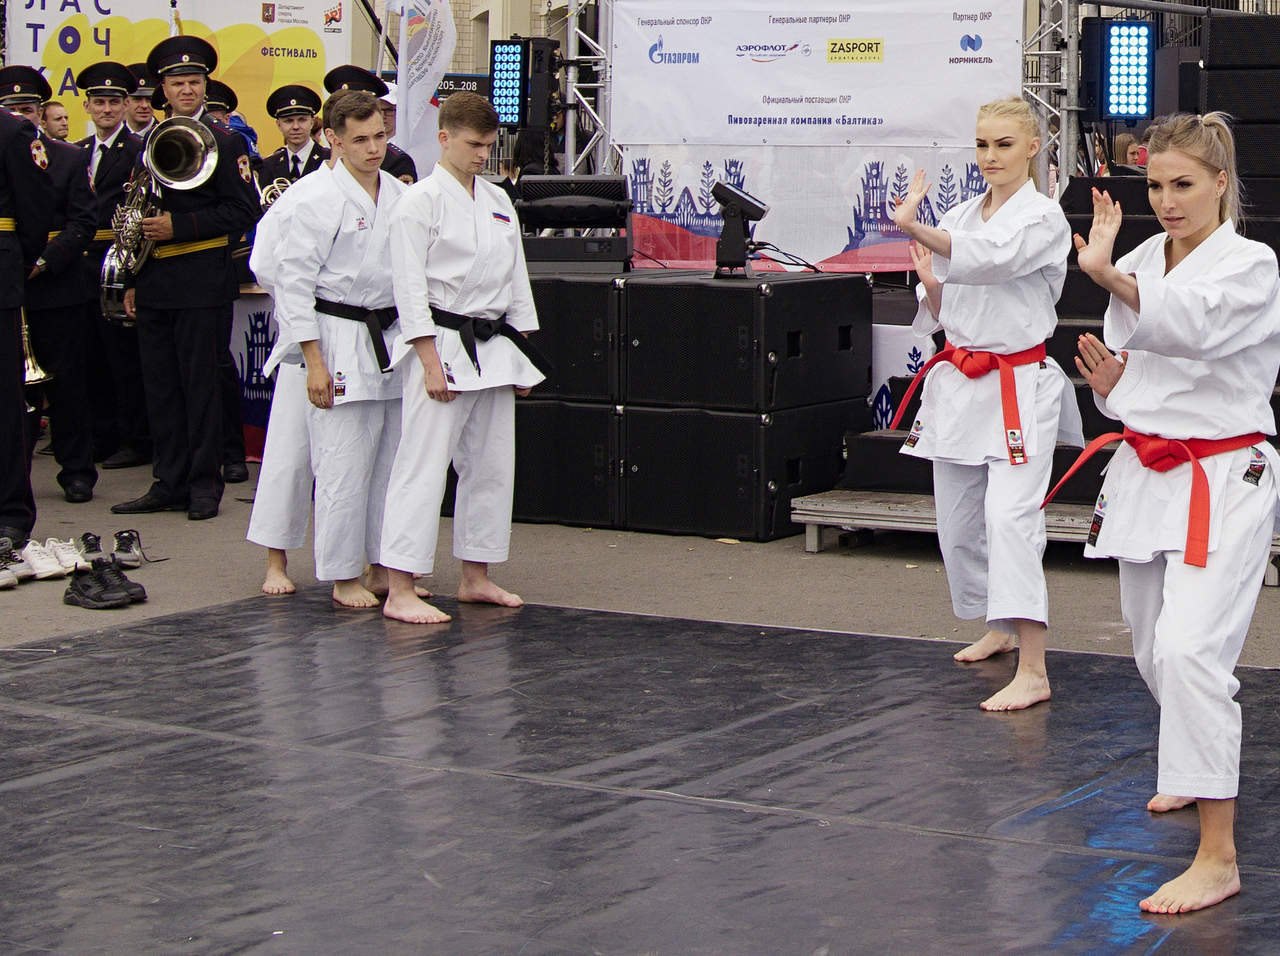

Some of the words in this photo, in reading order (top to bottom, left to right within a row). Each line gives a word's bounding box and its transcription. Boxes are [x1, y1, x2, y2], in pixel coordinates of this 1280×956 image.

[637, 17, 675, 27] Генеральный
[676, 18, 699, 26] спонсор
[700, 16, 712, 25] ОКР
[768, 15, 807, 25] Генеральные
[808, 15, 837, 25] партнеры
[838, 14, 851, 23] ОКР
[952, 12, 978, 22] Партнер
[979, 11, 992, 21] ОКР
[261, 47, 317, 58] ФЕСТИВАЛЬ
[830, 42, 880, 53] ZASPORT
[663, 52, 699, 64] ГАЗПРОМ
[949, 56, 993, 64] НОРНИКЕЛЬ
[762, 95, 803, 105] Официальный
[804, 97, 837, 105] поставщик
[838, 95, 851, 104] ОКР
[728, 115, 787, 127] Пивоваренная
[790, 116, 832, 125] компания
[835, 115, 883, 126] «Балтика»
